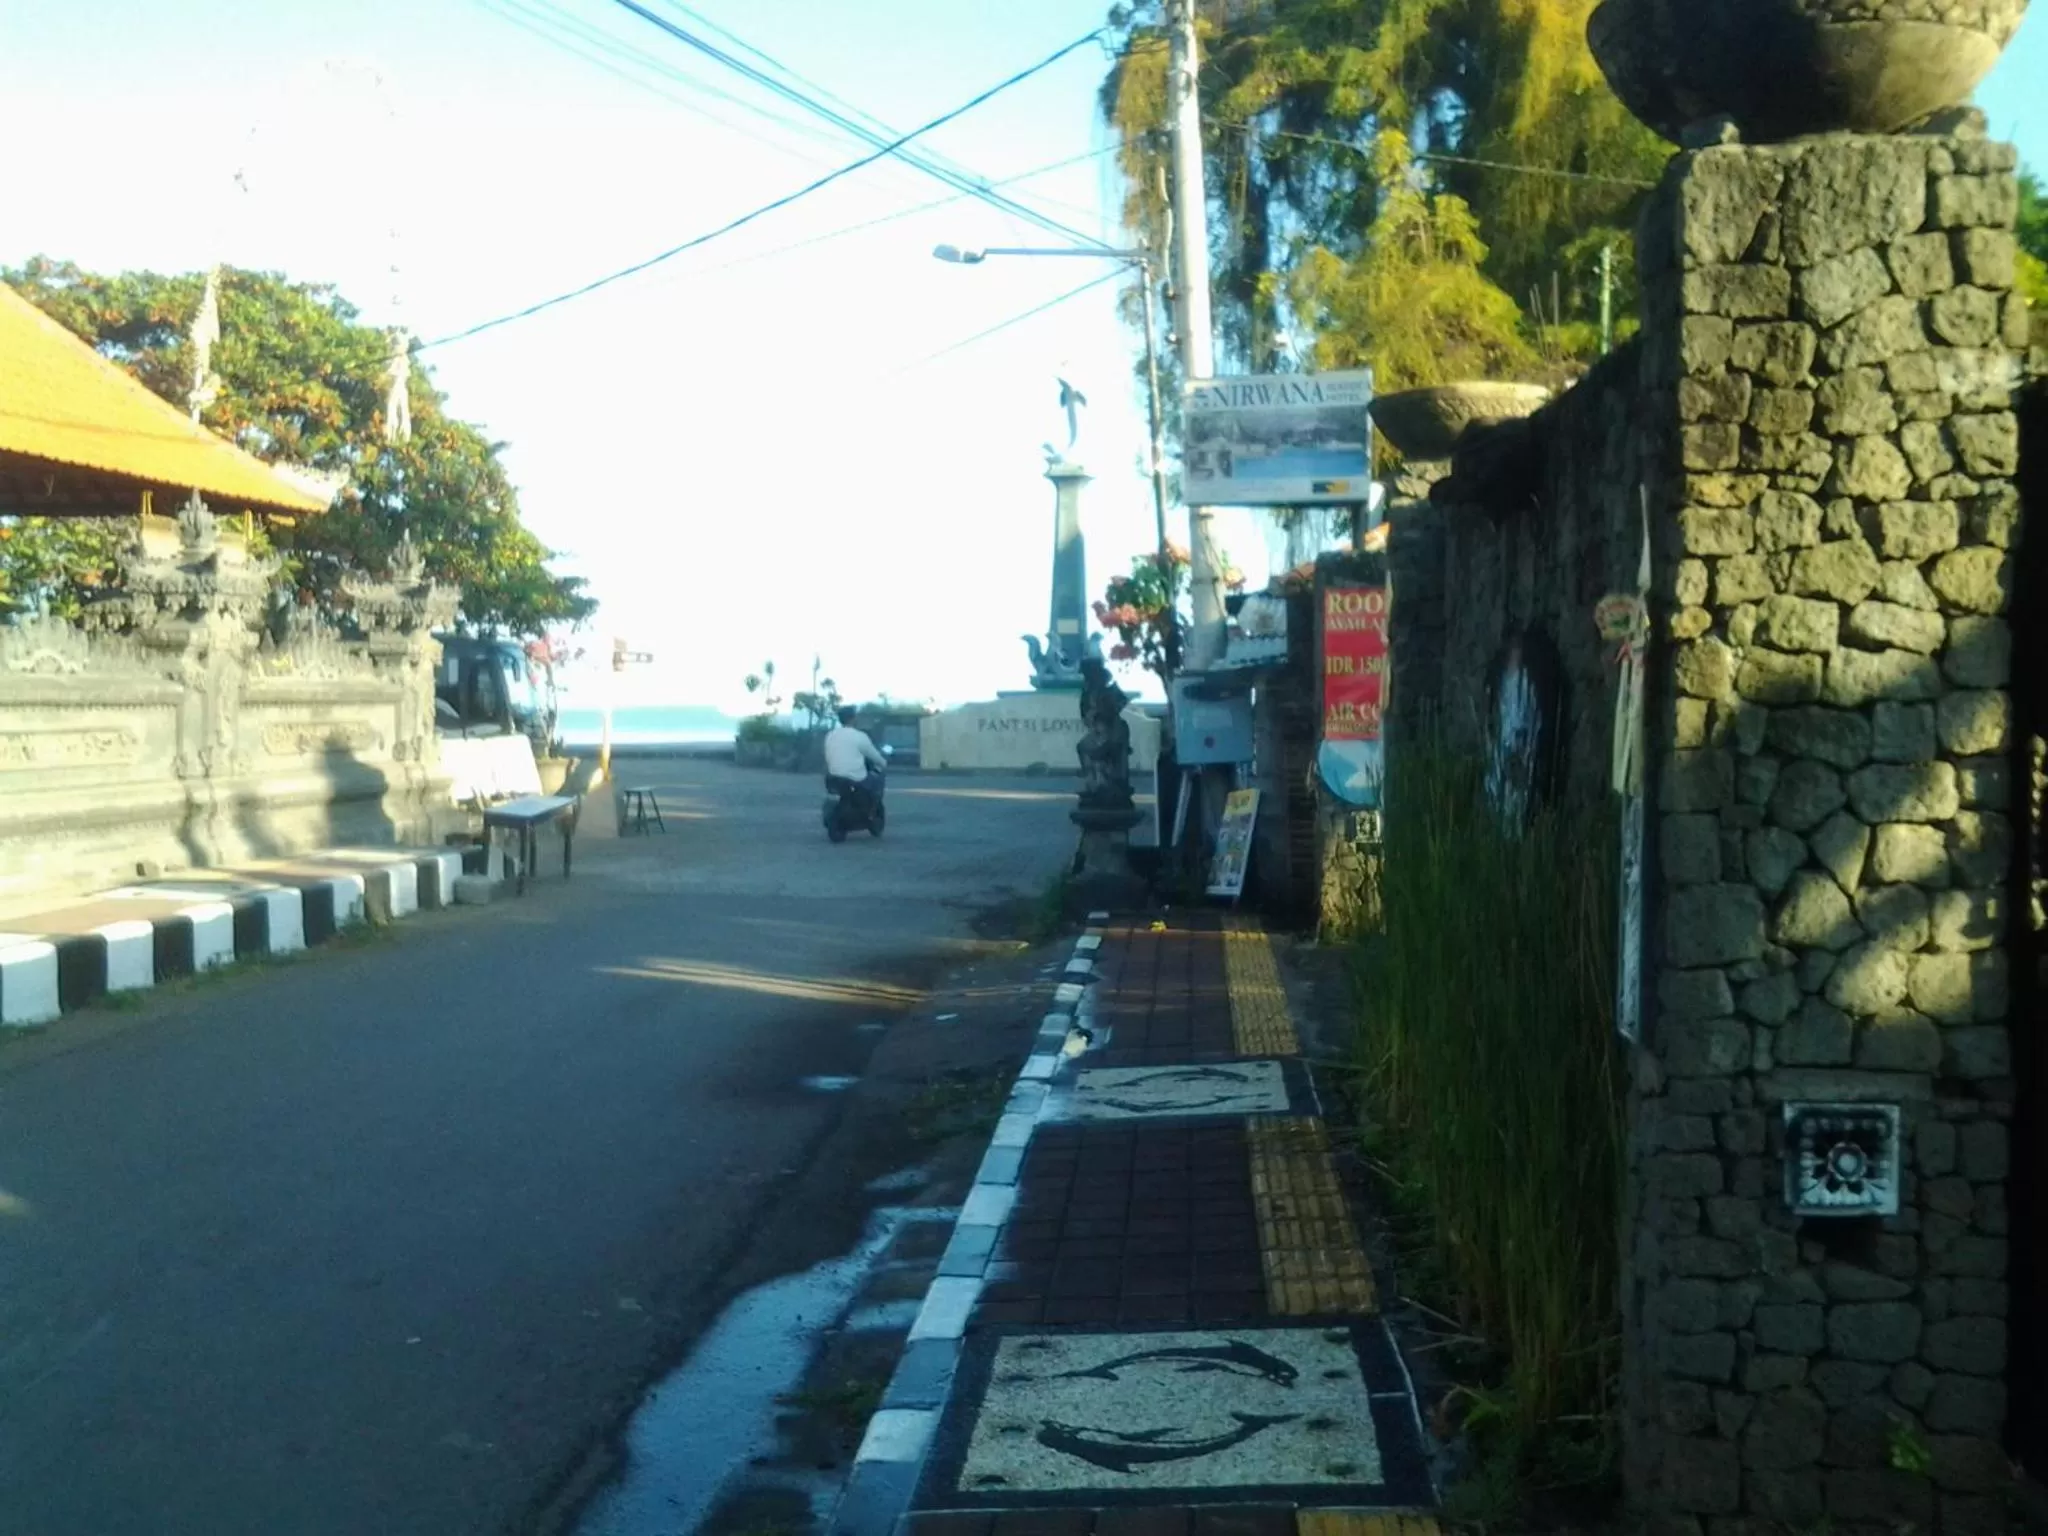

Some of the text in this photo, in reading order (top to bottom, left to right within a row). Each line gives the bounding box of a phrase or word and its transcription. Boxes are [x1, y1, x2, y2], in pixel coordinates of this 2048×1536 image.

[1213, 381, 1325, 408] NIRWANA
[1327, 592, 1384, 614] ROO
[1326, 615, 1383, 631] AVAILA
[1326, 656, 1354, 674] IDR
